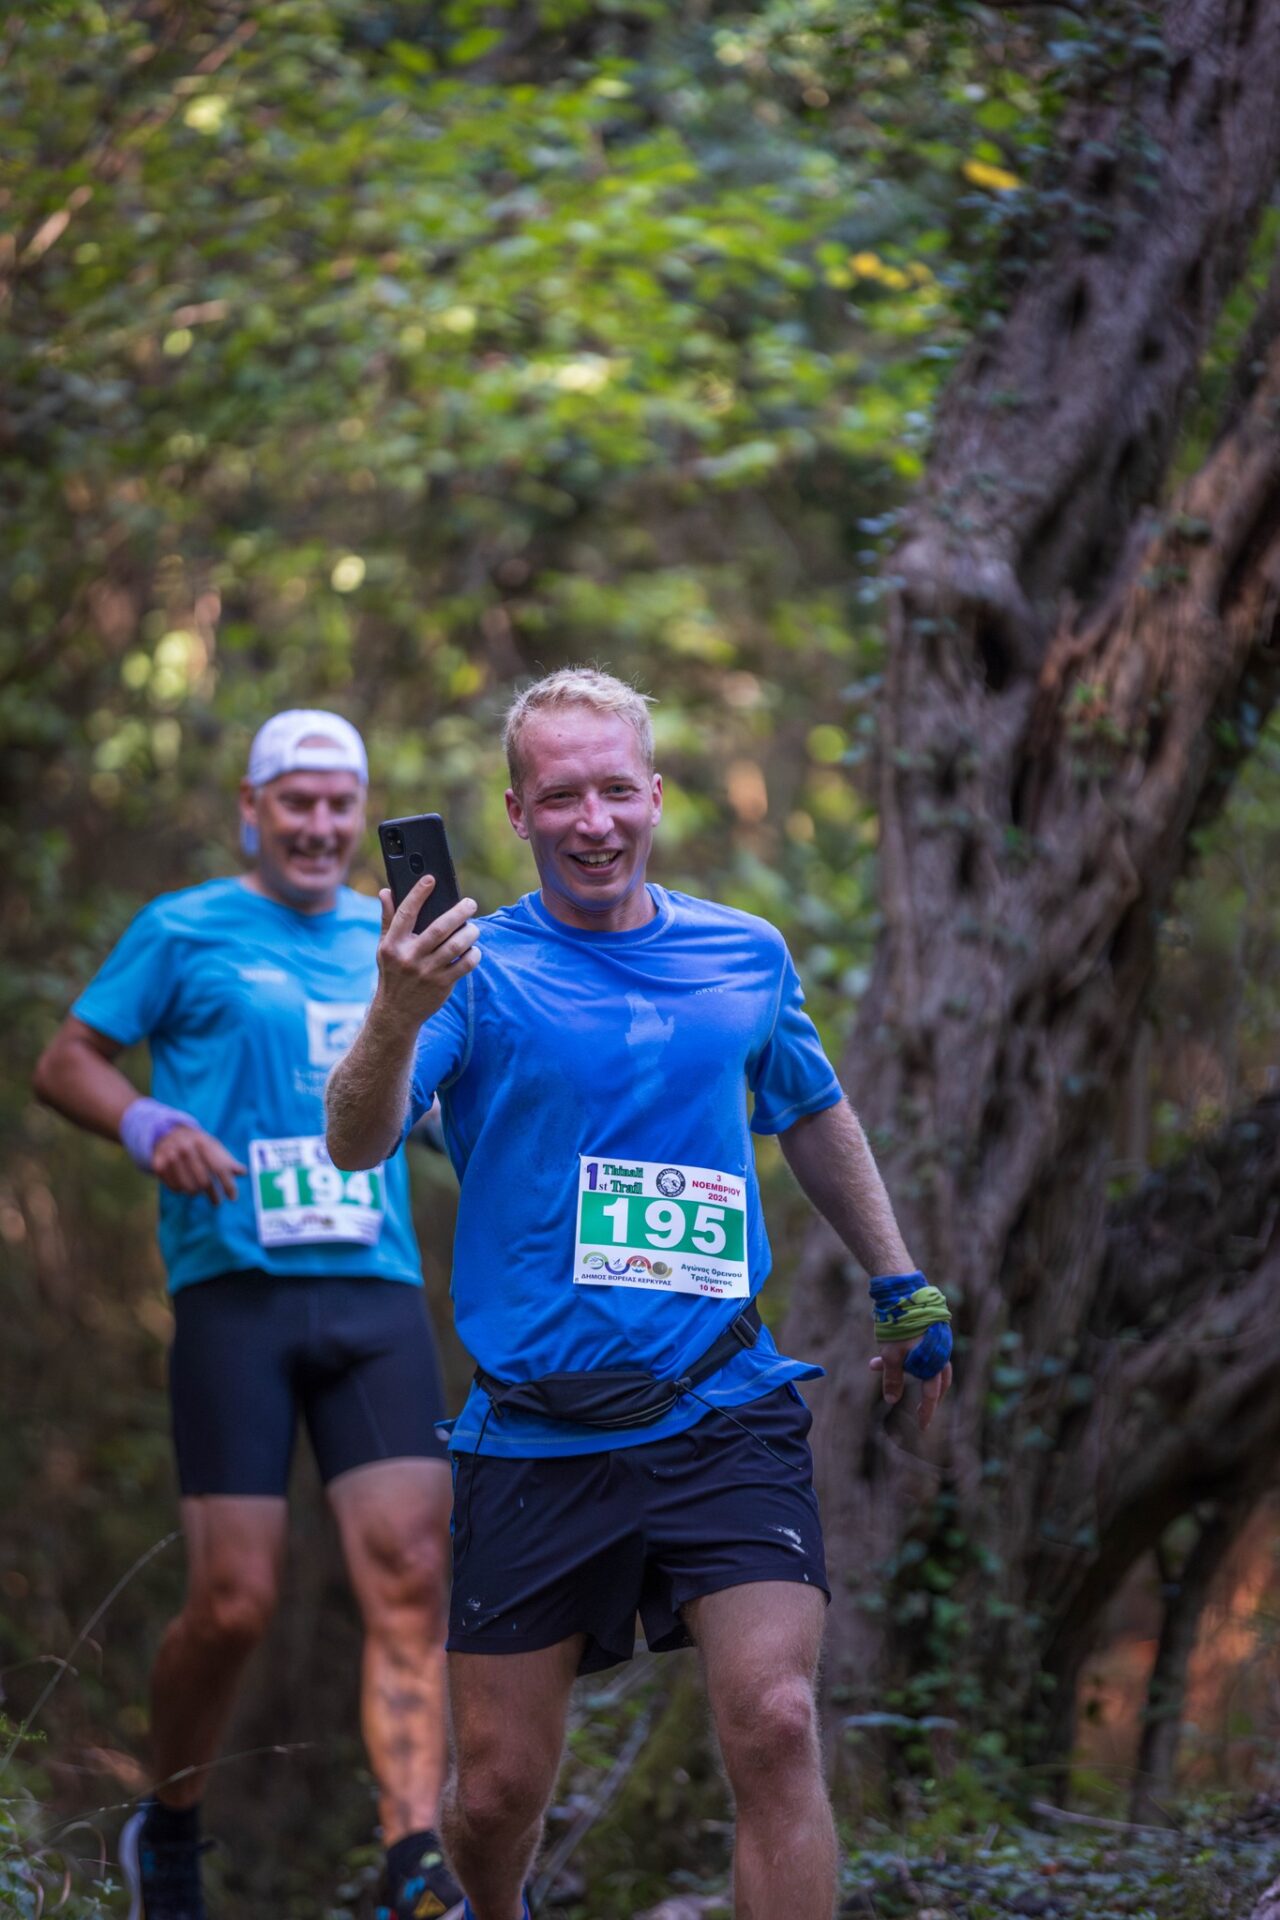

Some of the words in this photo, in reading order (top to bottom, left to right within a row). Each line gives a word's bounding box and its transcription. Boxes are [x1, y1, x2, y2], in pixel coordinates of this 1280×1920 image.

[586, 1163, 599, 1191] 1
[602, 1164, 644, 1178] Thinali
[273, 1168, 374, 1209] 194
[598, 1183, 608, 1191] st
[610, 1180, 643, 1195] Trail
[692, 1180, 741, 1196] ΝΟΕΜΒΡΙΟΥ
[708, 1192, 728, 1204] 2024
[602, 1197, 727, 1255] 195
[681, 1263, 710, 1275] Αγώνας
[581, 1273, 607, 1281] ΔΗΜΟΣ
[608, 1275, 637, 1283] ΒΟΡΕΙΑΣ
[637, 1278, 672, 1286] ΚΕΡΚΥΡΑΣ
[710, 1286, 724, 1294] Km
